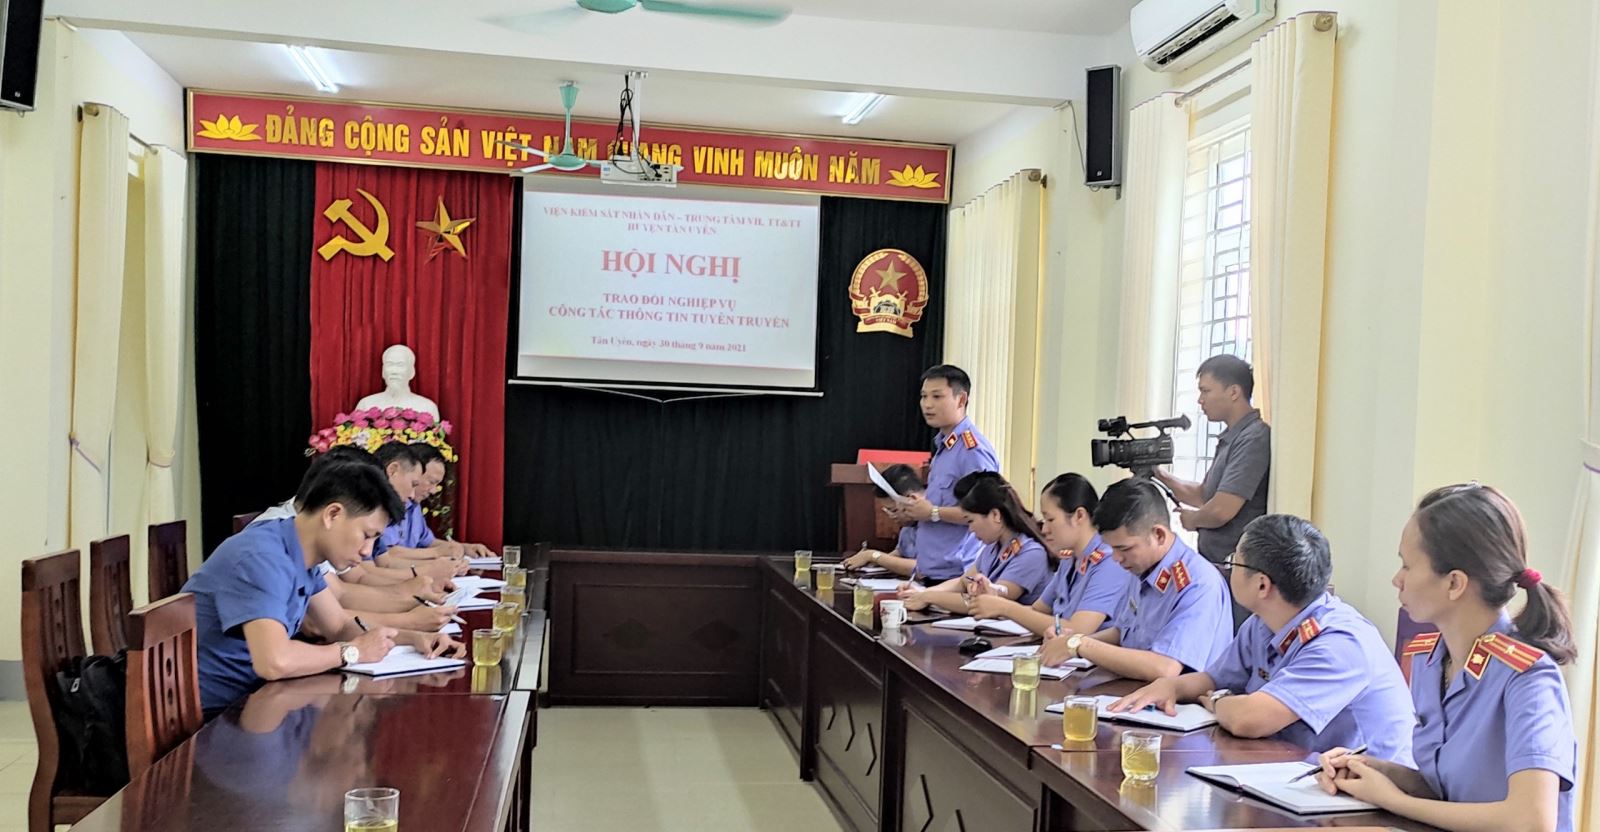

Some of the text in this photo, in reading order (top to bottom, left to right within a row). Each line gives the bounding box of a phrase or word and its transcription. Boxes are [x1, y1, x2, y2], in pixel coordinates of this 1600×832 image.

[265, 104, 335, 148] ĐẢNG
[344, 114, 409, 157] CỘNG
[419, 115, 470, 158] SẢN
[481, 125, 532, 167] VIỆT
[543, 135, 598, 163] NM
[693, 146, 745, 176] VINH
[754, 146, 819, 181] MUÔN
[828, 151, 881, 185] NĂM
[600, 248, 742, 283] HỘI NGHỊ
[603, 292, 638, 305] TRAO
[719, 299, 737, 311] VỤ
[548, 303, 586, 317] CÔNG
[588, 306, 615, 319] TÁC
[617, 307, 663, 321] THÔNG
[667, 312, 688, 322] TIN
[727, 343, 747, 353] 2021
